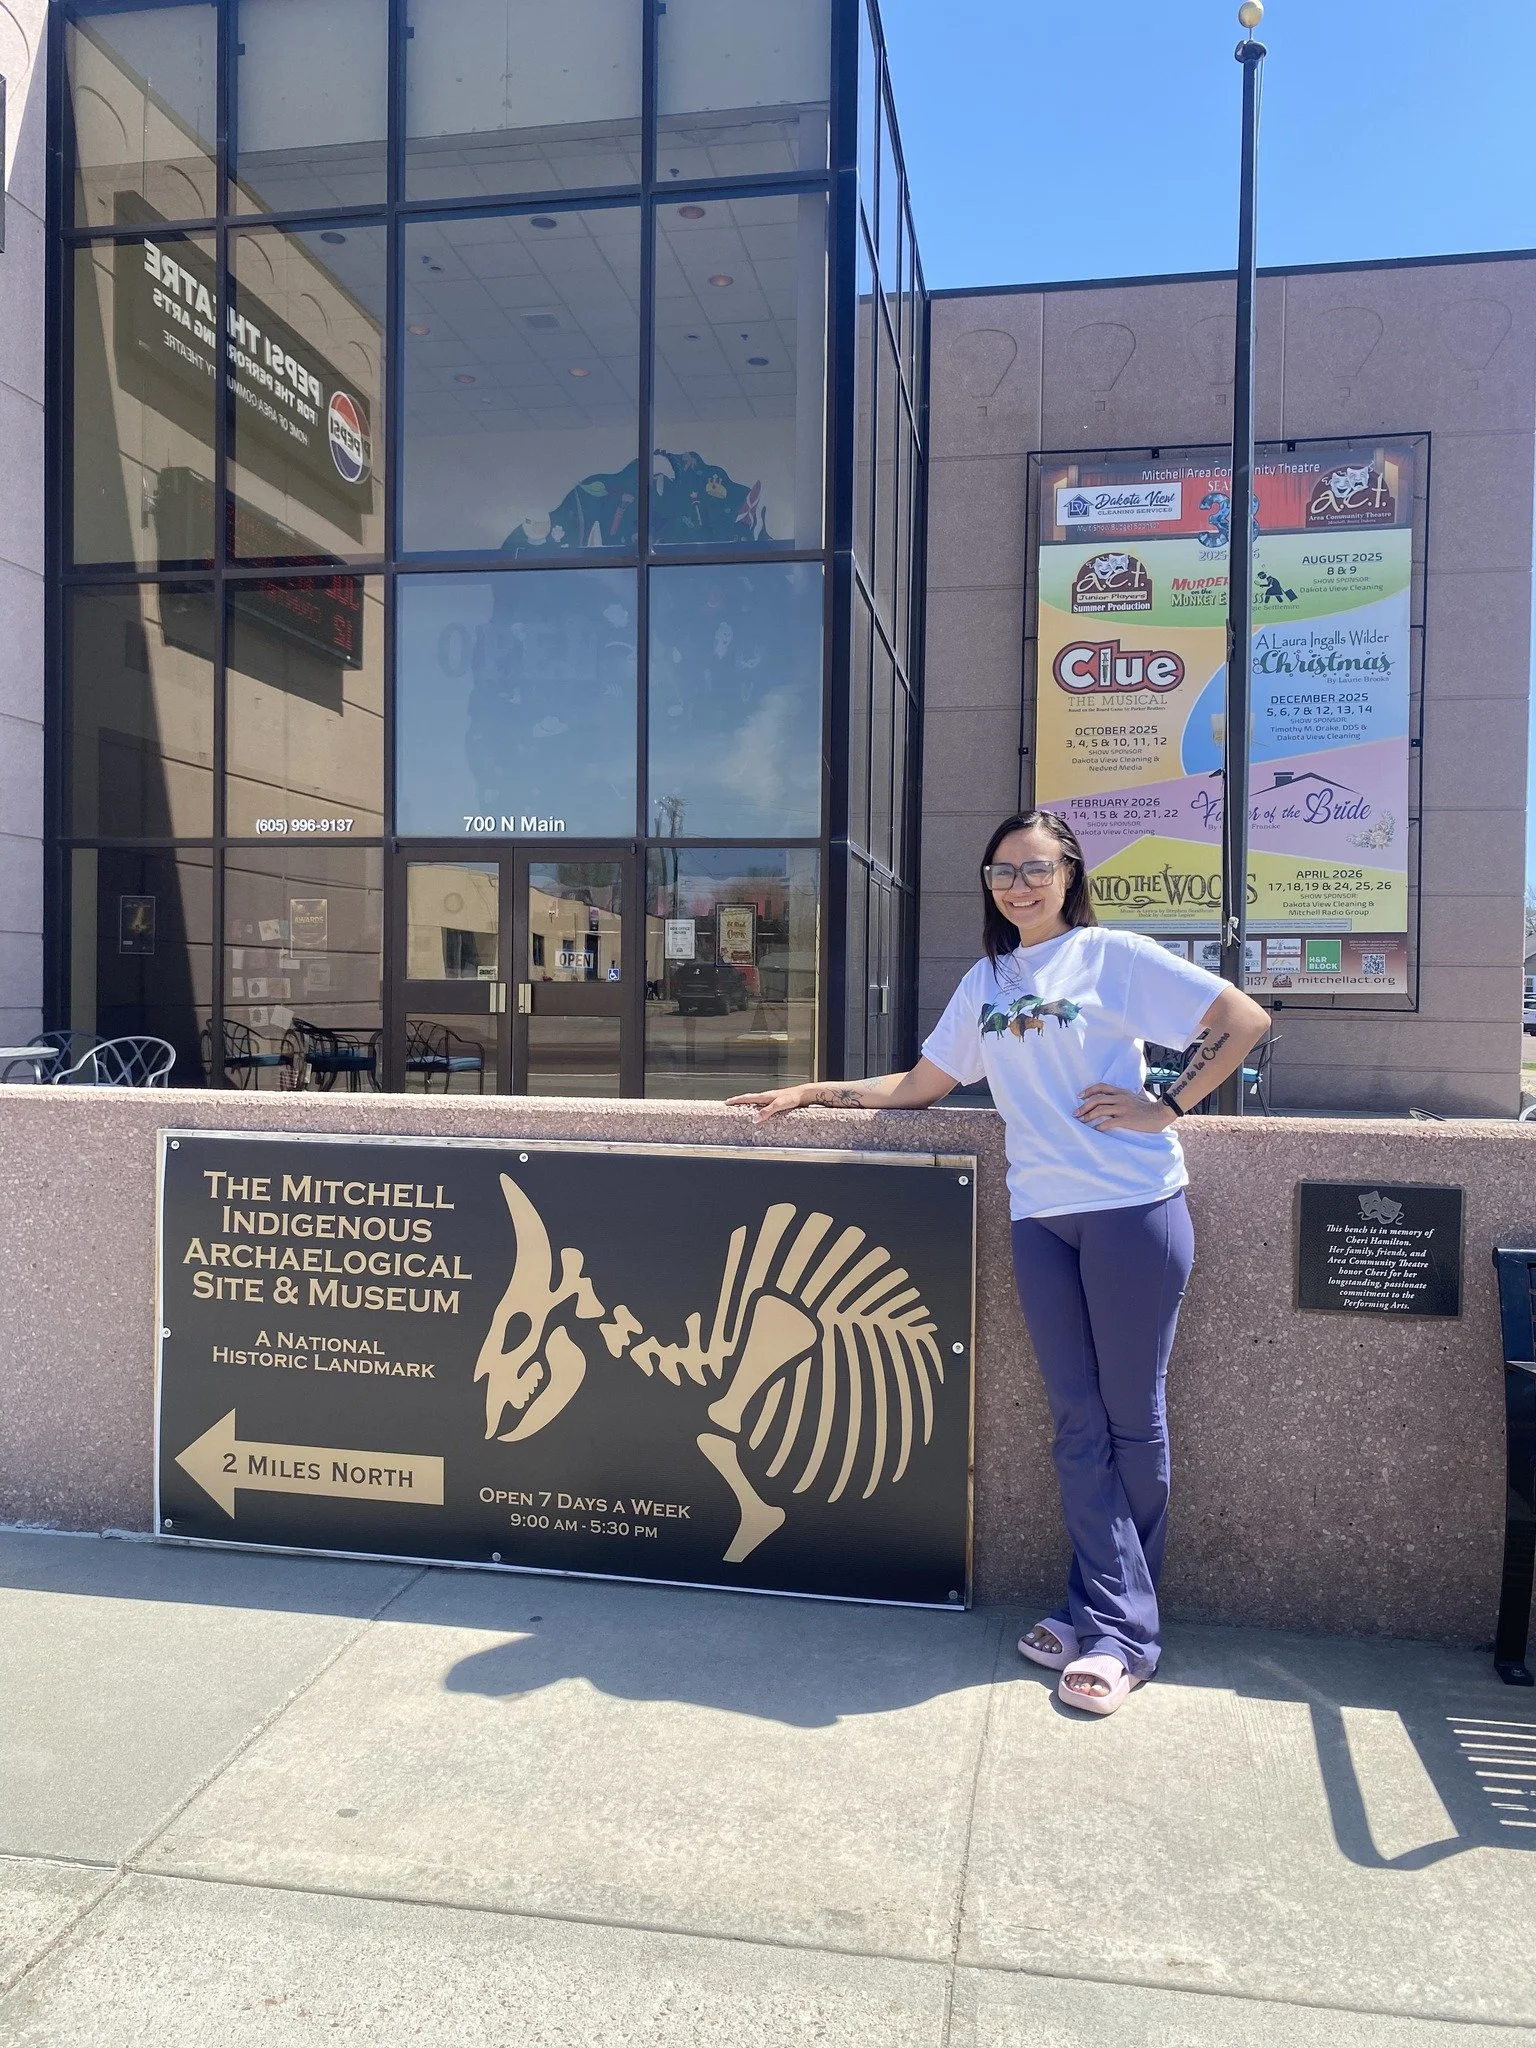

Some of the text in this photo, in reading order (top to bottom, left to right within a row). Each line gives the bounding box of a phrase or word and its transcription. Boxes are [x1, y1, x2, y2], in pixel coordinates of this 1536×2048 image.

[1142, 462, 1320, 480] Mitchell Area Theatre
[1095, 491, 1175, 509] Dakota View
[1326, 512, 1364, 520] Community
[1302, 553, 1382, 564] AUGUST 2025
[1327, 566, 1356, 575] 8 & 9
[1350, 584, 1383, 592] Cleaning
[1079, 593, 1109, 601] Junior
[1171, 593, 1215, 608] MONKEY
[1073, 602, 1150, 612] Summer Production
[1256, 629, 1389, 650] A Laura Ingalls Wilder
[1060, 647, 1179, 688] Clue
[1260, 650, 1395, 676] Christmas
[1068, 694, 1168, 707] THE MUSICAL
[1271, 693, 1369, 704] DECEMBER 2025
[1316, 705, 1372, 716] 12, 13, 14
[1076, 725, 1158, 736] OCTOBER 2025
[1271, 726, 1302, 734] Timothy
[1114, 737, 1167, 747] 10, 11, 12
[1327, 732, 1361, 741] Cleaning
[1120, 756, 1152, 764] Cleaning
[1071, 798, 1160, 808] FEBRUARY 2026
[1264, 788, 1372, 824] of the Bride
[1073, 809, 1178, 820] 14, 15 20, 21, 22
[256, 818, 353, 833] (605) 996-9137
[464, 816, 566, 832] 700 N Main
[1296, 870, 1363, 879] APRIL 2026
[1128, 864, 1258, 906] THE WOOS
[1335, 881, 1392, 891] 24, 25, 26
[1333, 901, 1366, 909] Cleaning
[1346, 909, 1369, 917] Group
[560, 952, 591, 968] OPEN
[1298, 976, 1395, 985] mitchellact.org
[203, 1170, 455, 1210] THE MITCHELL
[222, 1205, 433, 1243] INDIGENOUS
[1326, 1224, 1434, 1238] This bench is in memory of
[1346, 1236, 1412, 1246] Cheri Hamilton.
[1344, 1246, 1374, 1256] family,
[1375, 1248, 1407, 1258] friends,
[1410, 1250, 1427, 1258] and
[183, 1237, 472, 1280] ARCHAELOGICAL
[1327, 1256, 1428, 1268] Area Community Theatre
[1338, 1267, 1417, 1278] honor Cheri for her
[1328, 1277, 1427, 1289] longstanding, passionate
[192, 1270, 460, 1314] SITE & MUSEUM
[1339, 1290, 1389, 1298] commitment
[1402, 1291, 1414, 1299] the
[1343, 1299, 1410, 1310] Performing Arts.
[255, 1330, 385, 1356] A NATIONAL
[212, 1346, 436, 1379] HISTORIC LANDMARK
[222, 1452, 414, 1489] 2 MILES NORTH
[478, 1486, 691, 1520] OPEN 7 DAYS A WEEK
[510, 1512, 658, 1539] 9:00 AM 5:30 PM
